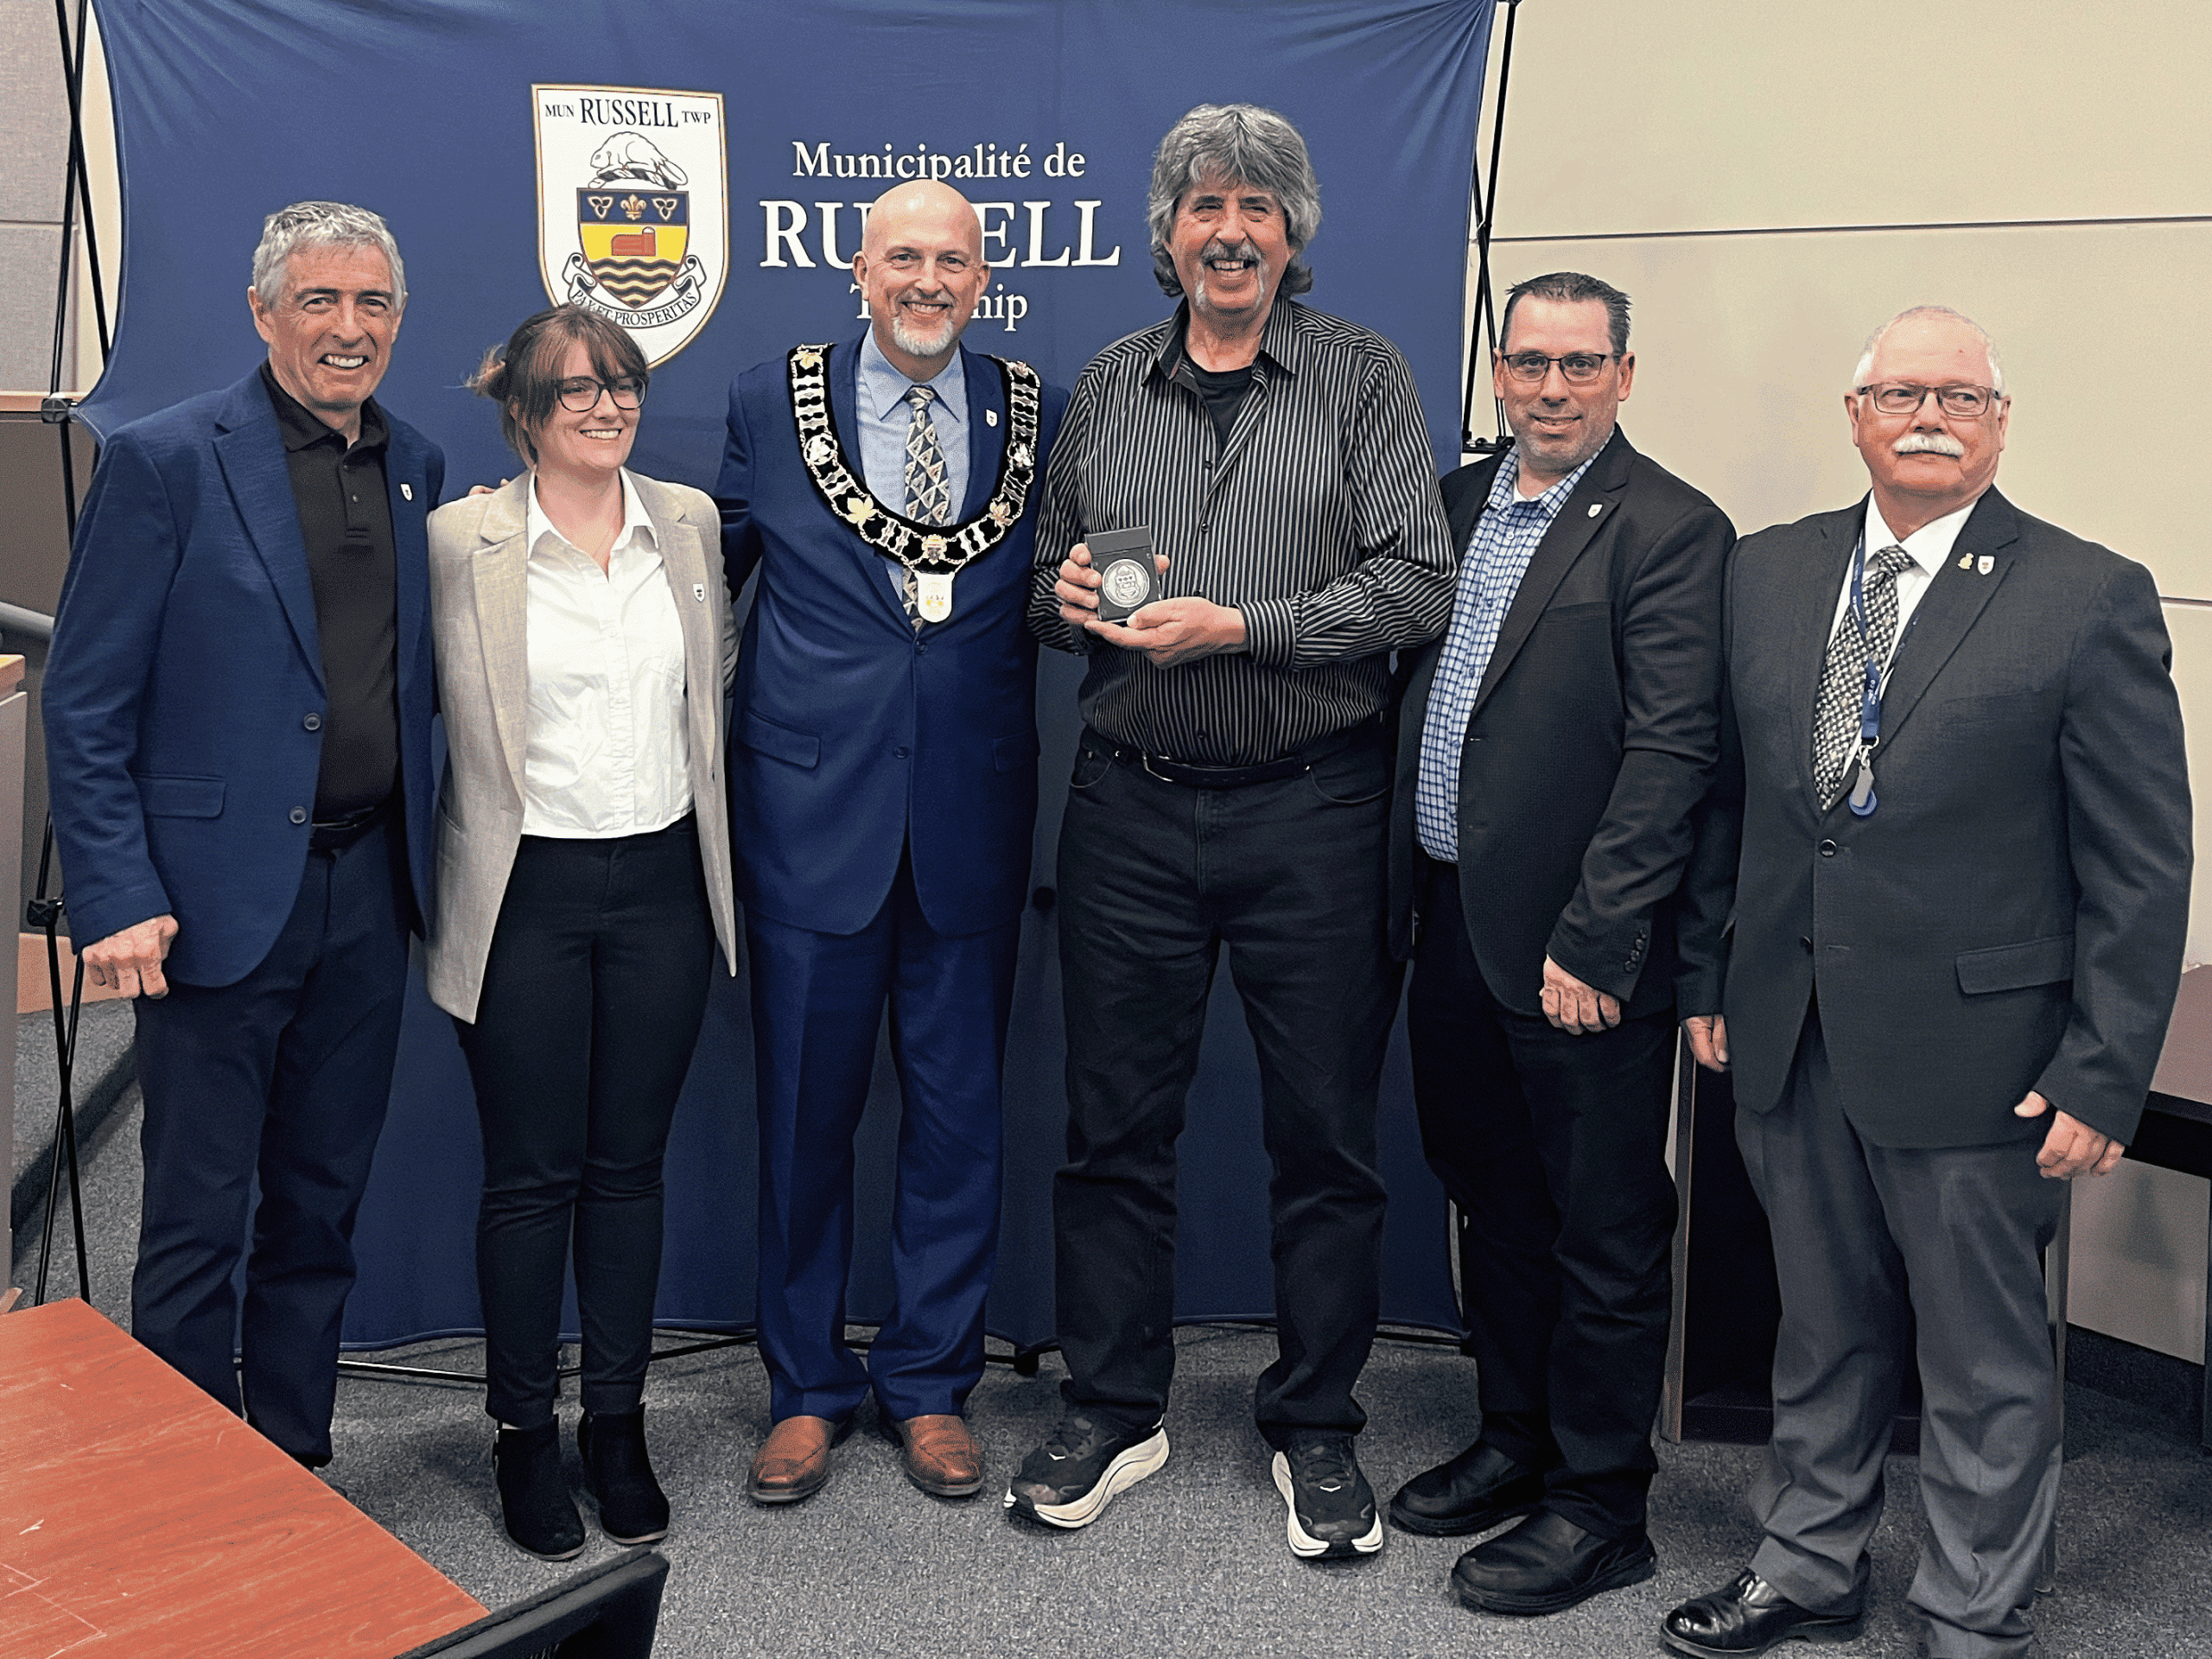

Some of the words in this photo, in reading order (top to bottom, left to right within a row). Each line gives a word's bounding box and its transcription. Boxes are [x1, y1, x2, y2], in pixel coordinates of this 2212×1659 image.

[544, 104, 575, 118] MUN
[579, 98, 679, 128] RUSSELL
[682, 111, 711, 124] TWP
[791, 141, 1032, 181] Municipalité
[1044, 142, 1086, 178] de
[759, 200, 1121, 270] RUELL
